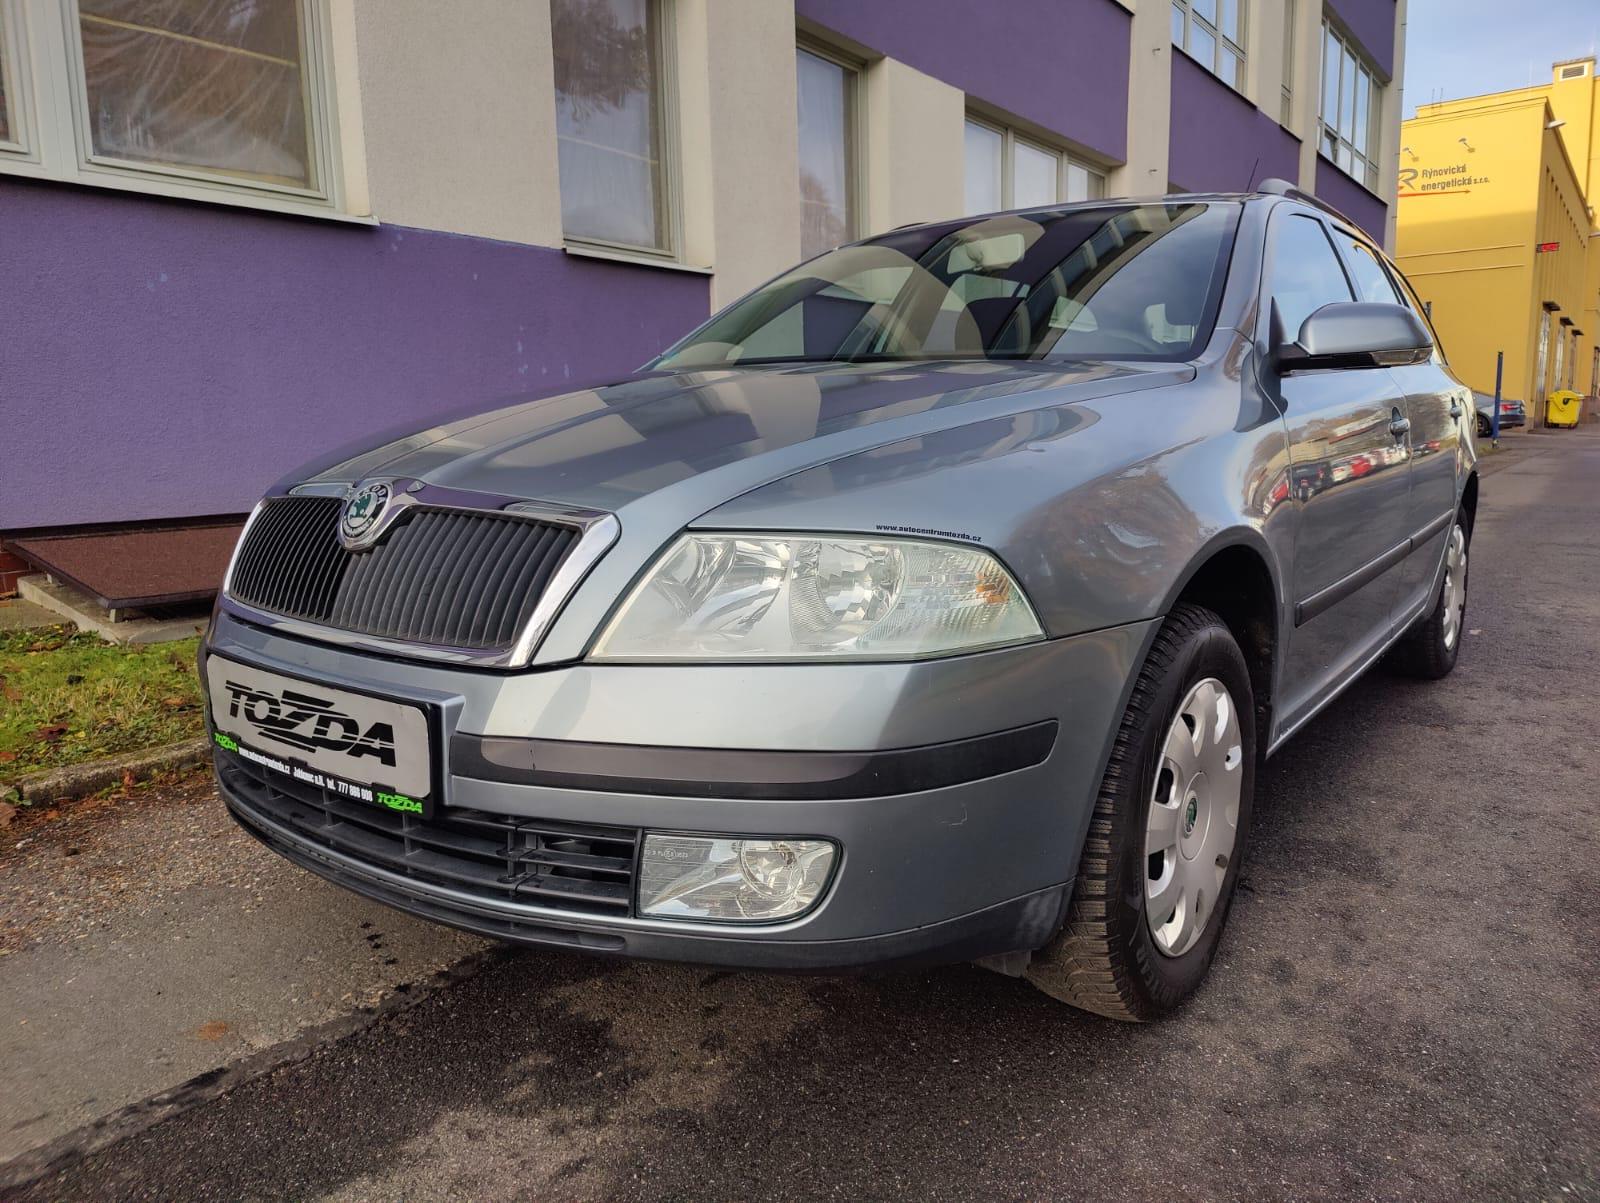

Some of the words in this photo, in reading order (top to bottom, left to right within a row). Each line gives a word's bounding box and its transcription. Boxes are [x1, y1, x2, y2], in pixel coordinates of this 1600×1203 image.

[1421, 164, 1467, 179] Rýnovická
[1421, 176, 1472, 191] energetická
[876, 524, 982, 541] www.autocentrumtozda.cz
[225, 680, 397, 767] TOZDA
[377, 792, 422, 814] TOZDA
